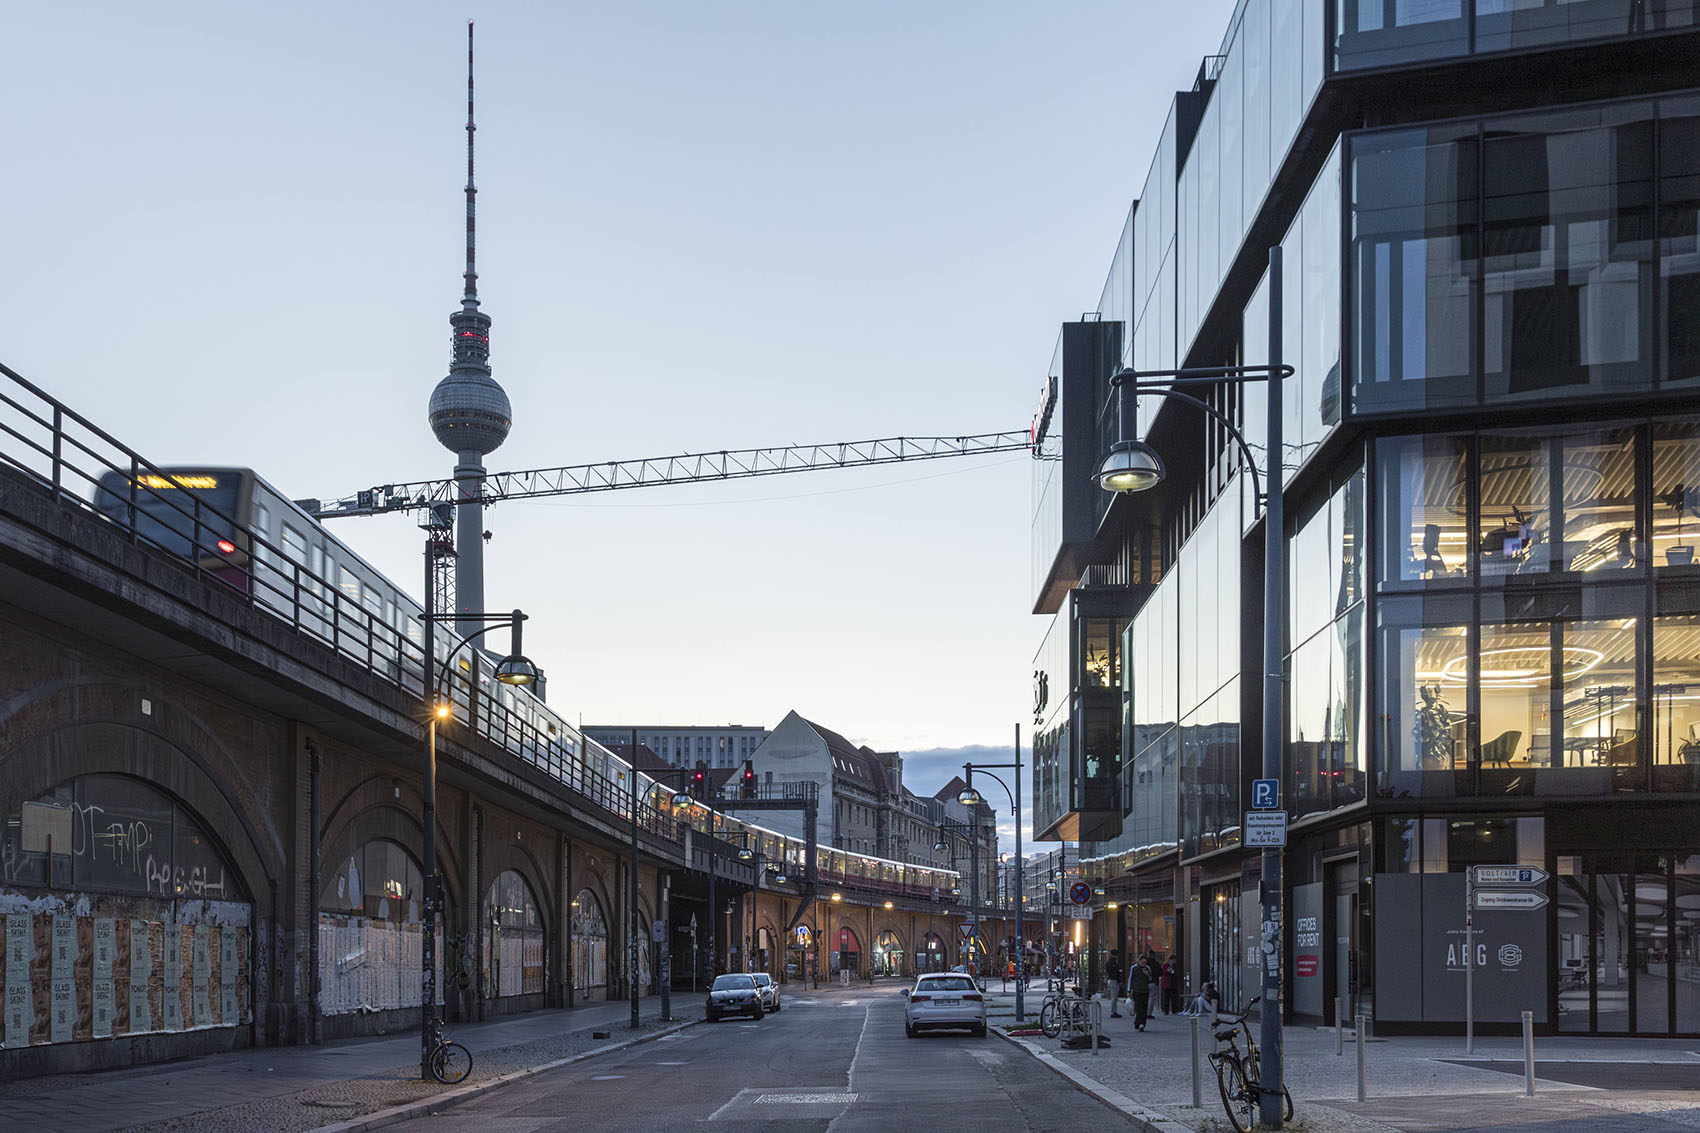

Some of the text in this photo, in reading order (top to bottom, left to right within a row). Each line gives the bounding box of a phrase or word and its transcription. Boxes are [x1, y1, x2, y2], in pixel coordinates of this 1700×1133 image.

[1256, 783, 1270, 804] P
[10, 920, 27, 928] GLASS
[56, 920, 71, 928] GLASS
[1297, 917, 1317, 932] OFFICES
[1297, 933, 1320, 947] FOR RENT
[9, 986, 26, 995] GLASS
[55, 984, 70, 992] GLASS
[10, 996, 25, 1004] SKIN?
